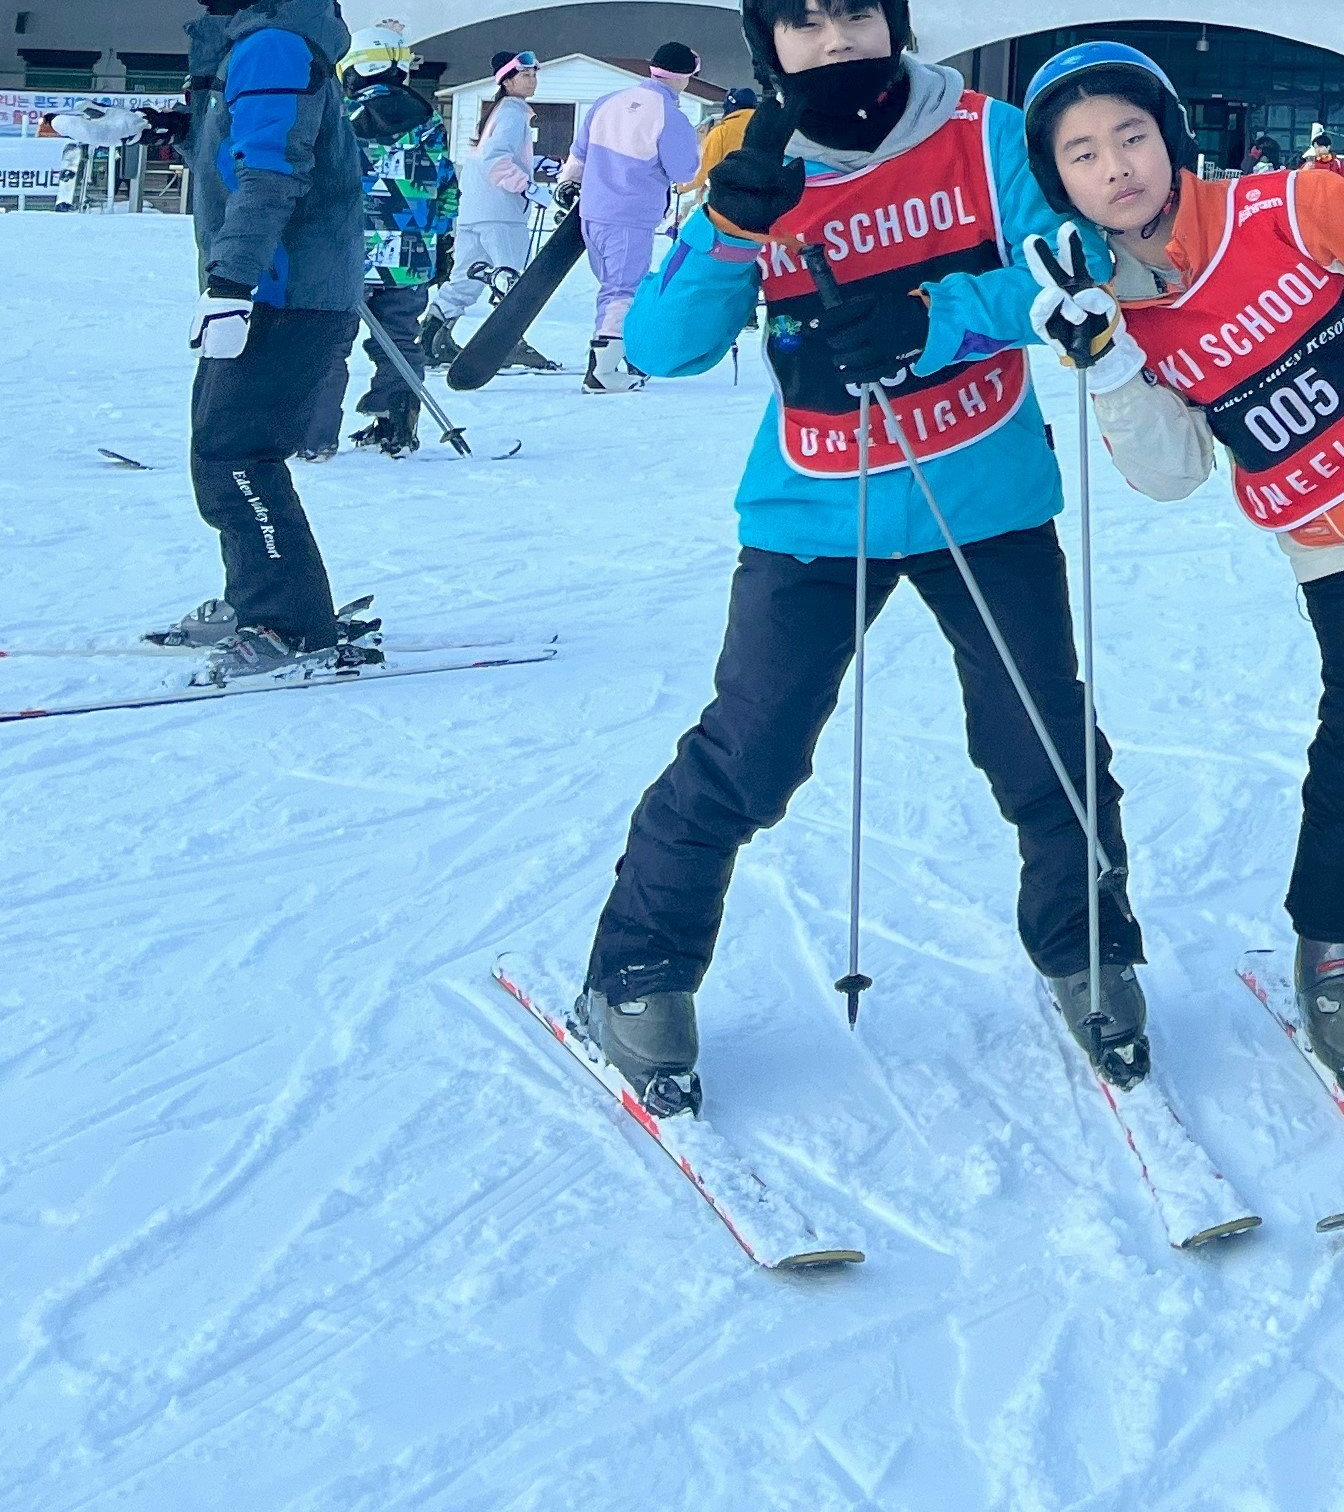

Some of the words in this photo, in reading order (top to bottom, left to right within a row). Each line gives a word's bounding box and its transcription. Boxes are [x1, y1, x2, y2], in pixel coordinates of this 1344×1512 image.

[823, 186, 977, 261] SCHOOL
[1199, 262, 1330, 369] SCHOOL
[1243, 366, 1340, 453] 005
[232, 470, 254, 496] Eden
[247, 496, 270, 523] Valley
[260, 525, 282, 559] Resort
